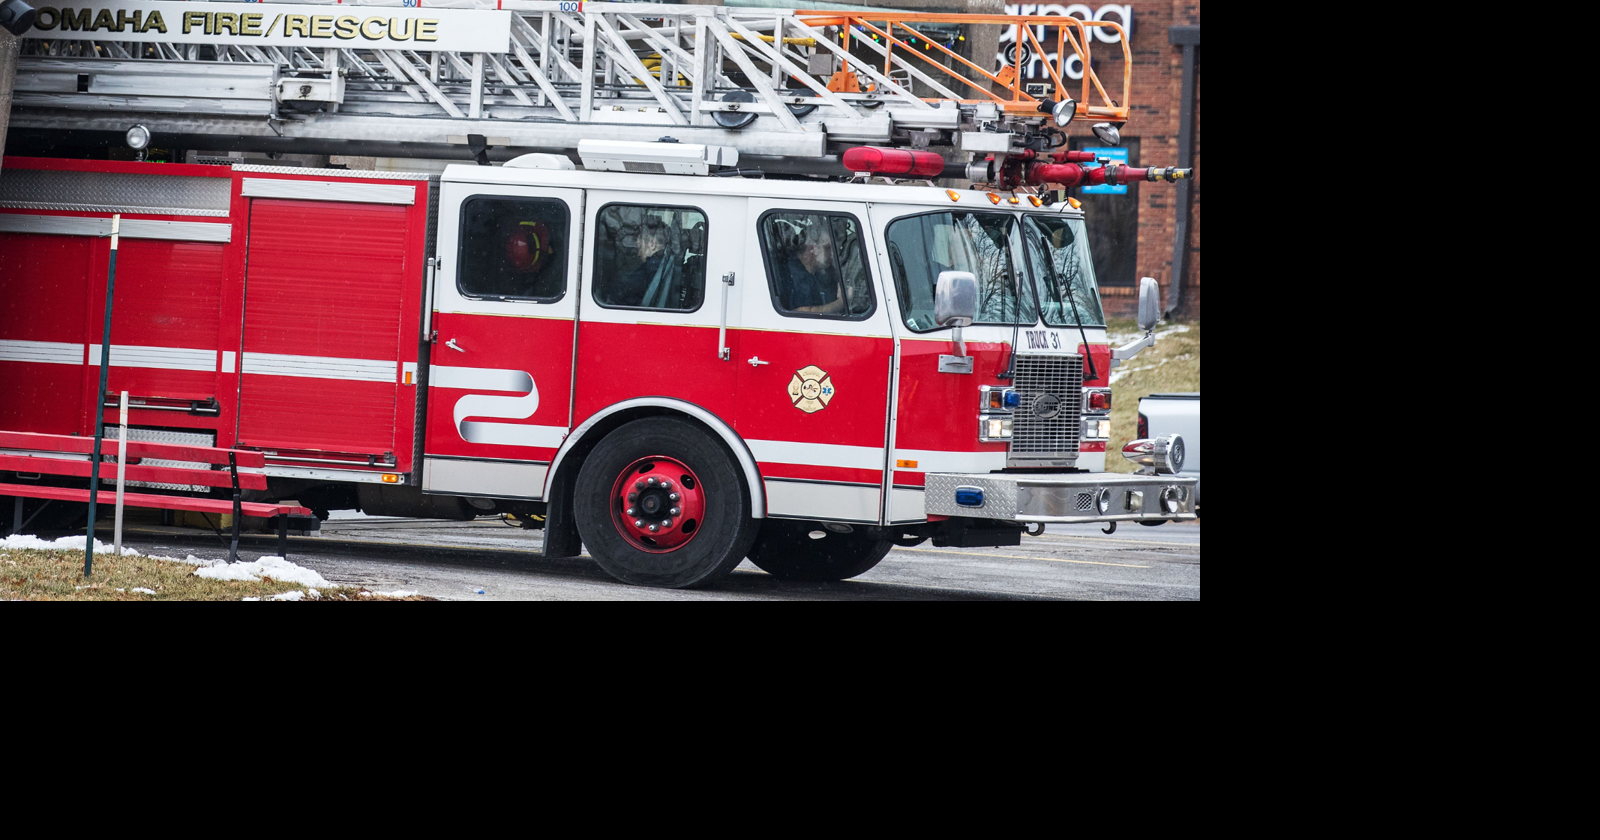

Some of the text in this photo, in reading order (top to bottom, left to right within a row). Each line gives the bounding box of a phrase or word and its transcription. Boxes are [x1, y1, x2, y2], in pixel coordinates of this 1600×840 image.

[559, 2, 577, 11] 100
[33, 7, 439, 42] OMAHA FIRE/RESCUE
[1025, 330, 1061, 349] TRUCK 31
